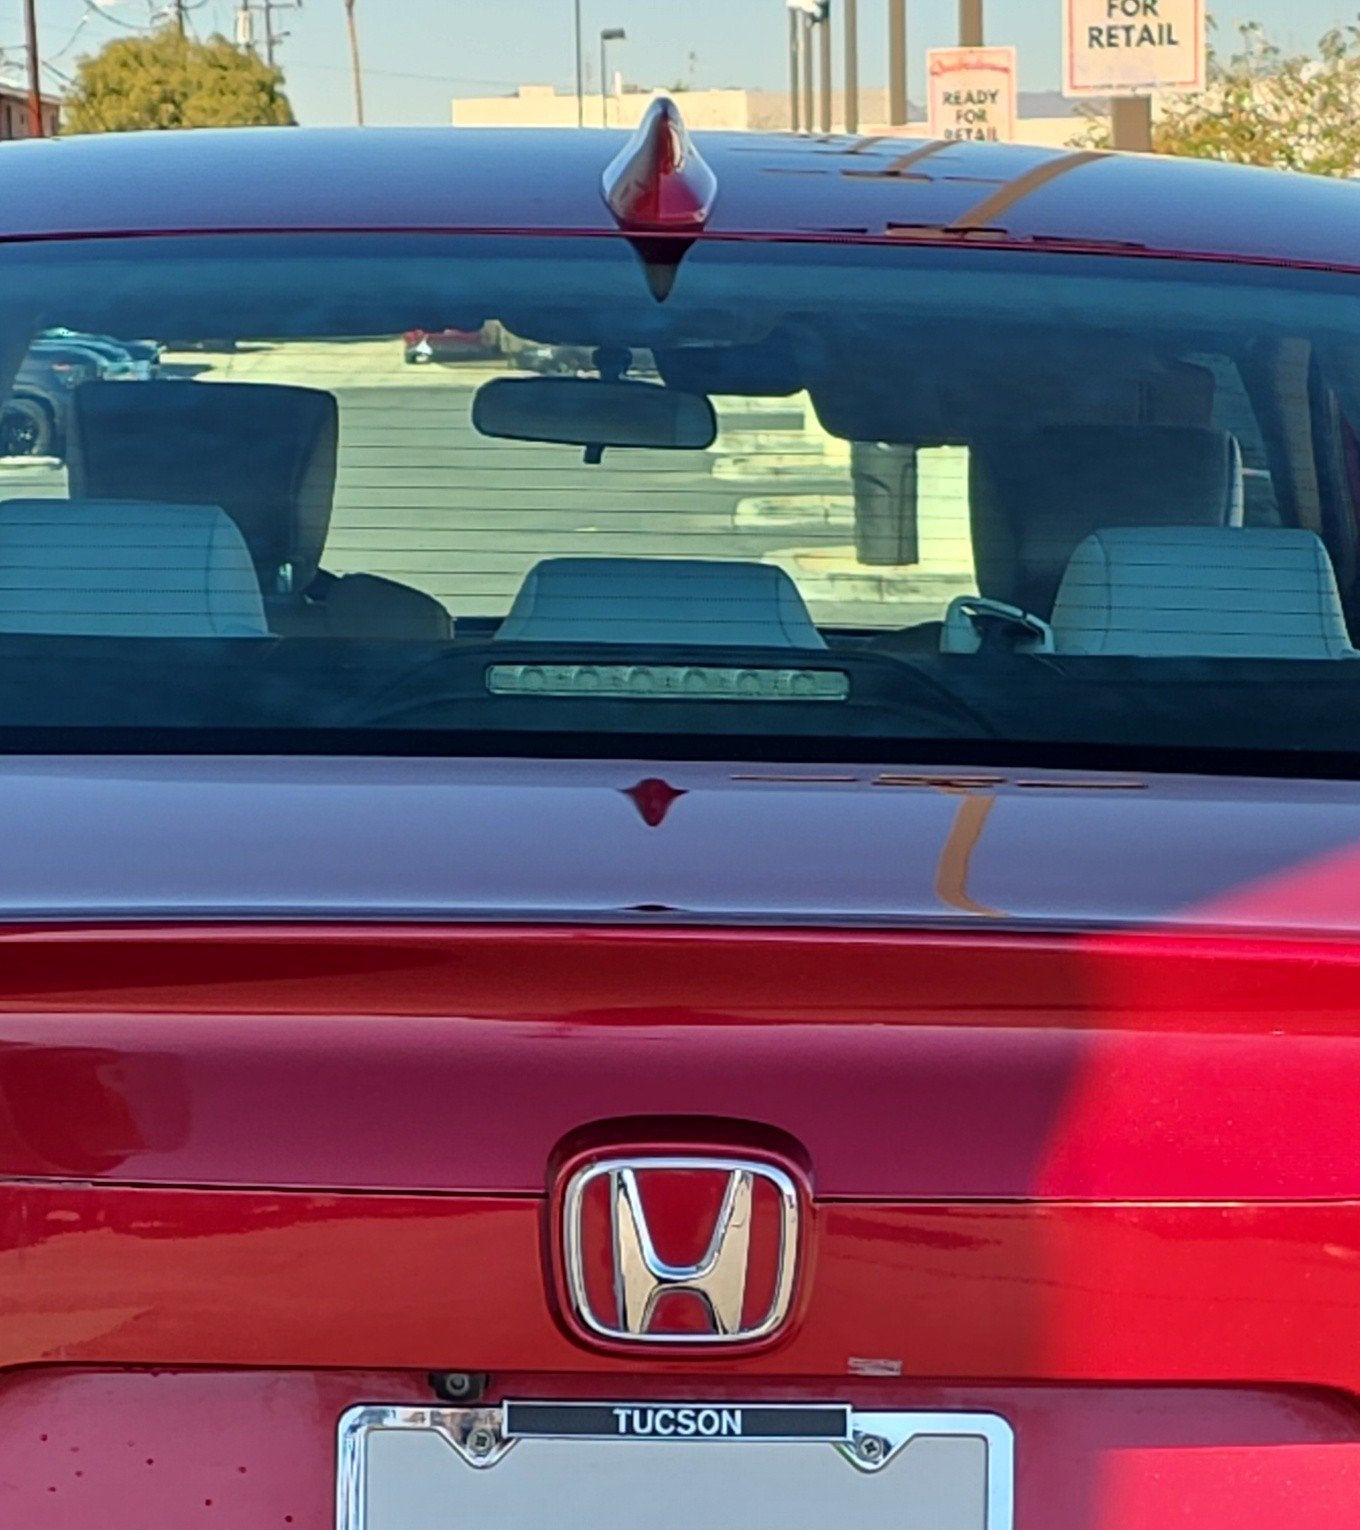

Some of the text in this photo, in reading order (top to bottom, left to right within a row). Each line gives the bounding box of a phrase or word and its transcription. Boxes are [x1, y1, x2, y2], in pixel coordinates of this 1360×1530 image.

[1107, 0, 1158, 18] FOR
[1087, 22, 1179, 49] RETAIL
[942, 88, 1000, 106] READY
[955, 107, 988, 124] FOR
[943, 126, 999, 142] RETAIL
[612, 1408, 742, 1436] TUCSON
